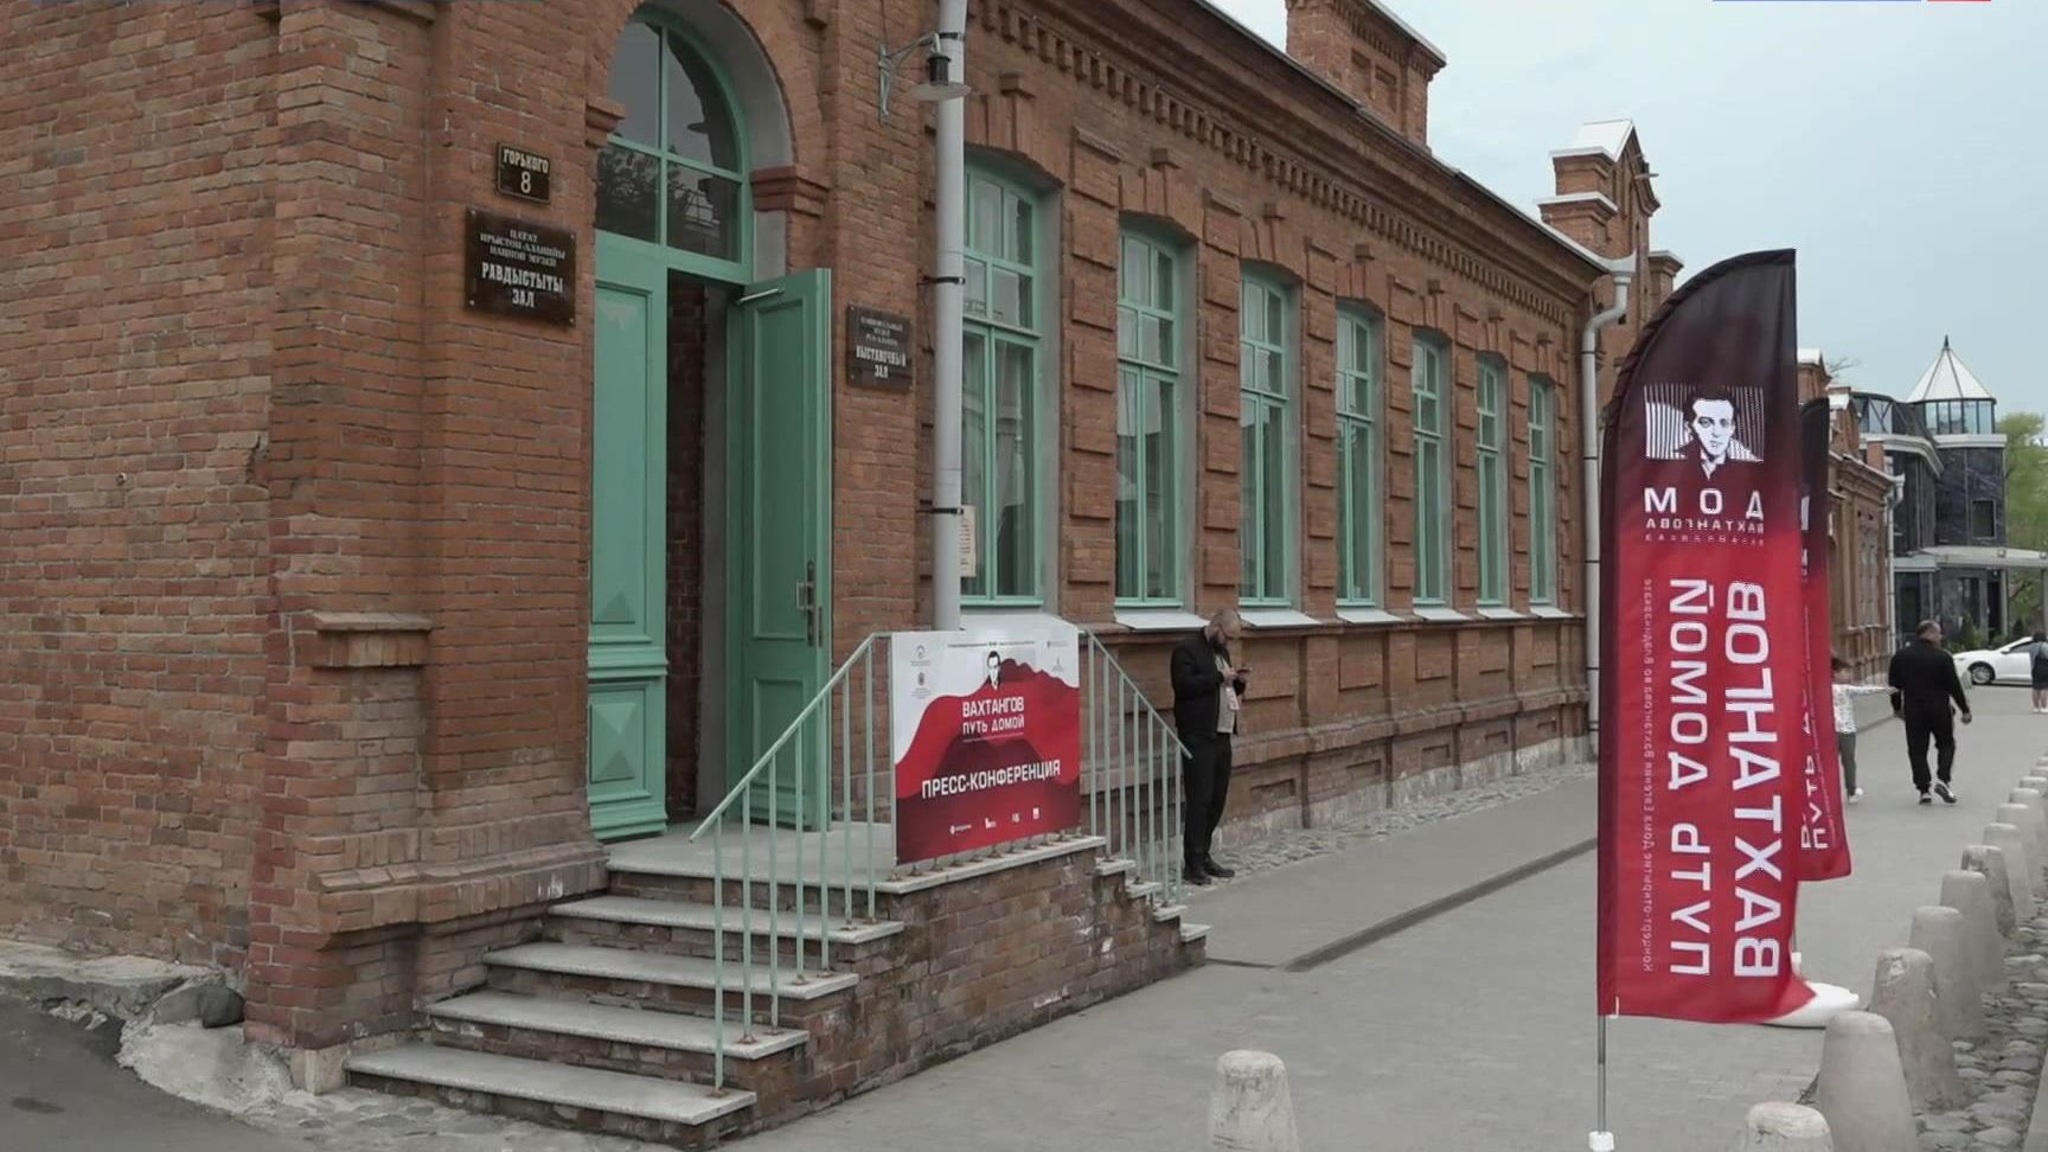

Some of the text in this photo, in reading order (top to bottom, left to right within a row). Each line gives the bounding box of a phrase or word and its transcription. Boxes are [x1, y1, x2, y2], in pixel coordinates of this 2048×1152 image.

[503, 149, 549, 174] ГОРЬКОГО
[520, 171, 532, 193] 8
[481, 261, 563, 293] РАВДЫСТЫТЫ
[512, 289, 535, 308] ЗАЛ
[963, 696, 1024, 718] ВАХТАНГОВ
[963, 715, 1025, 735] ПУТЬ ДОМОЙ
[922, 759, 1061, 799] ПРЕСС-КОНФЕРЕНЦИЯ
